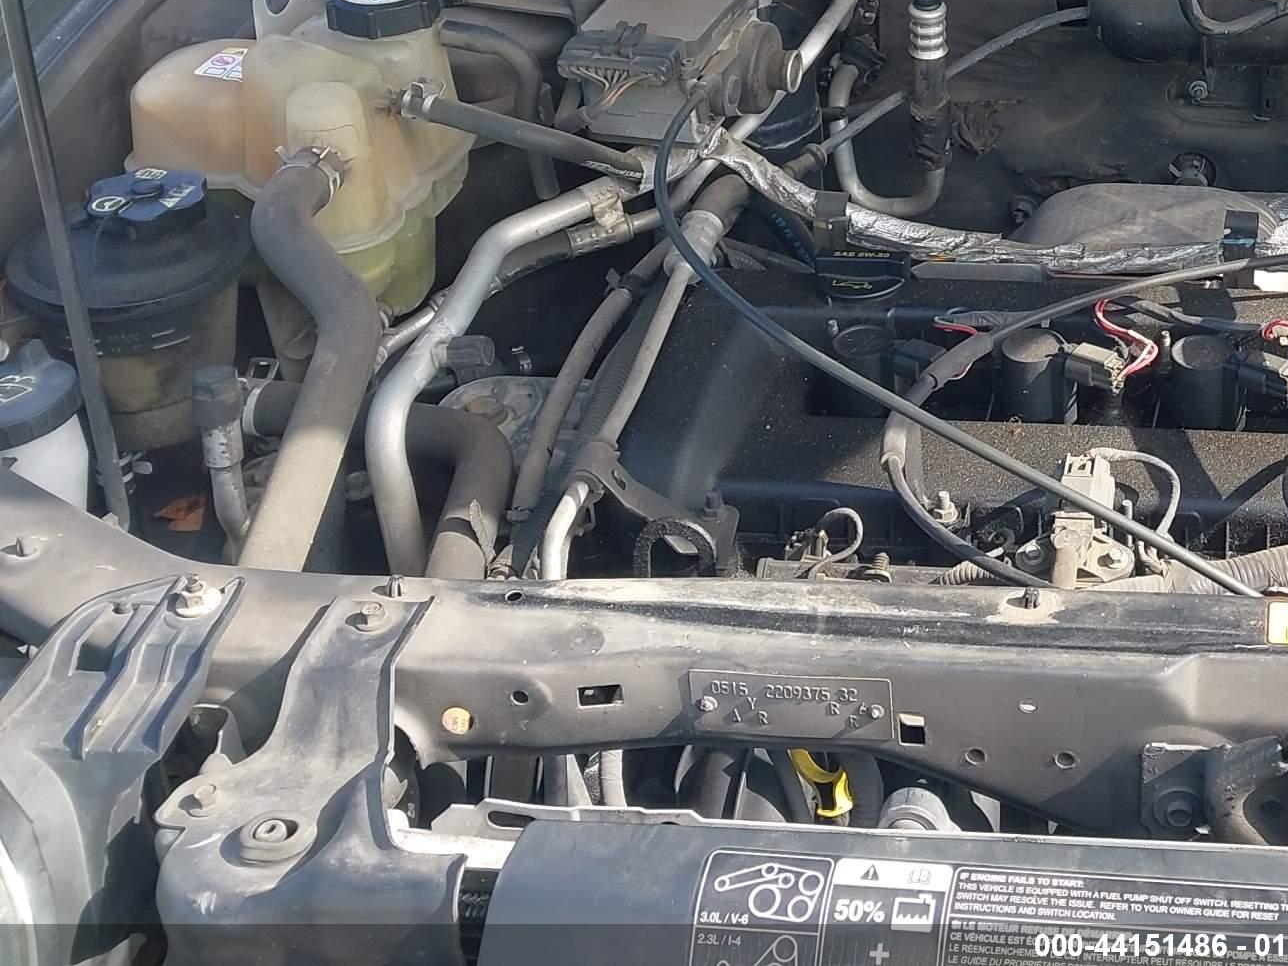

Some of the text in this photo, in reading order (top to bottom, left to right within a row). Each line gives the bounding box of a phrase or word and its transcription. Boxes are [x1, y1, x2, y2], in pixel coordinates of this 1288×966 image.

[766, 684, 831, 701] 2209375
[839, 687, 858, 702] 32
[747, 696, 757, 710] Y
[758, 710, 768, 725] R
[960, 872, 1085, 888] IF ENGINE FAILS TO START:
[958, 882, 978, 891] THIS
[979, 884, 1015, 893] VEHICLE
[1016, 886, 1024, 894] IS
[1026, 887, 1069, 897] EQUIPPED
[1070, 890, 1092, 899] WITH
[1100, 892, 1122, 901] FUEL
[1123, 894, 1149, 902] PUMP
[1149, 895, 1173, 904] SHUT
[1174, 897, 1192, 905] OFF
[1230, 900, 1280, 911] RESETTING
[834, 899, 885, 922] 50%
[954, 902, 1117, 921] INSTRUCTIONS AND SWITCH LOCATION.
[956, 892, 1279, 921] SWITCH MAY RESOLVE THE ISSUE. REFER TO YOUR OWNER GUIDE FOR RESET
[699, 911, 722, 923] 3.0L
[730, 913, 749, 924] V-6
[951, 920, 961, 930] SI
[963, 921, 976, 931] LE
[977, 922, 1019, 933] MOTEUR
[697, 933, 719, 944] 2.3L
[727, 936, 742, 946] I-4
[950, 932, 1026, 945] CE VÉHICULE EST
[949, 943, 960, 952] LE
[961, 944, 1047, 959] RÉENCLENCHEME
[948, 955, 959, 964] LE
[960, 956, 988, 966] GUIDE
[989, 957, 1002, 966] DU
[1150, 955, 1174, 966] PEUT
